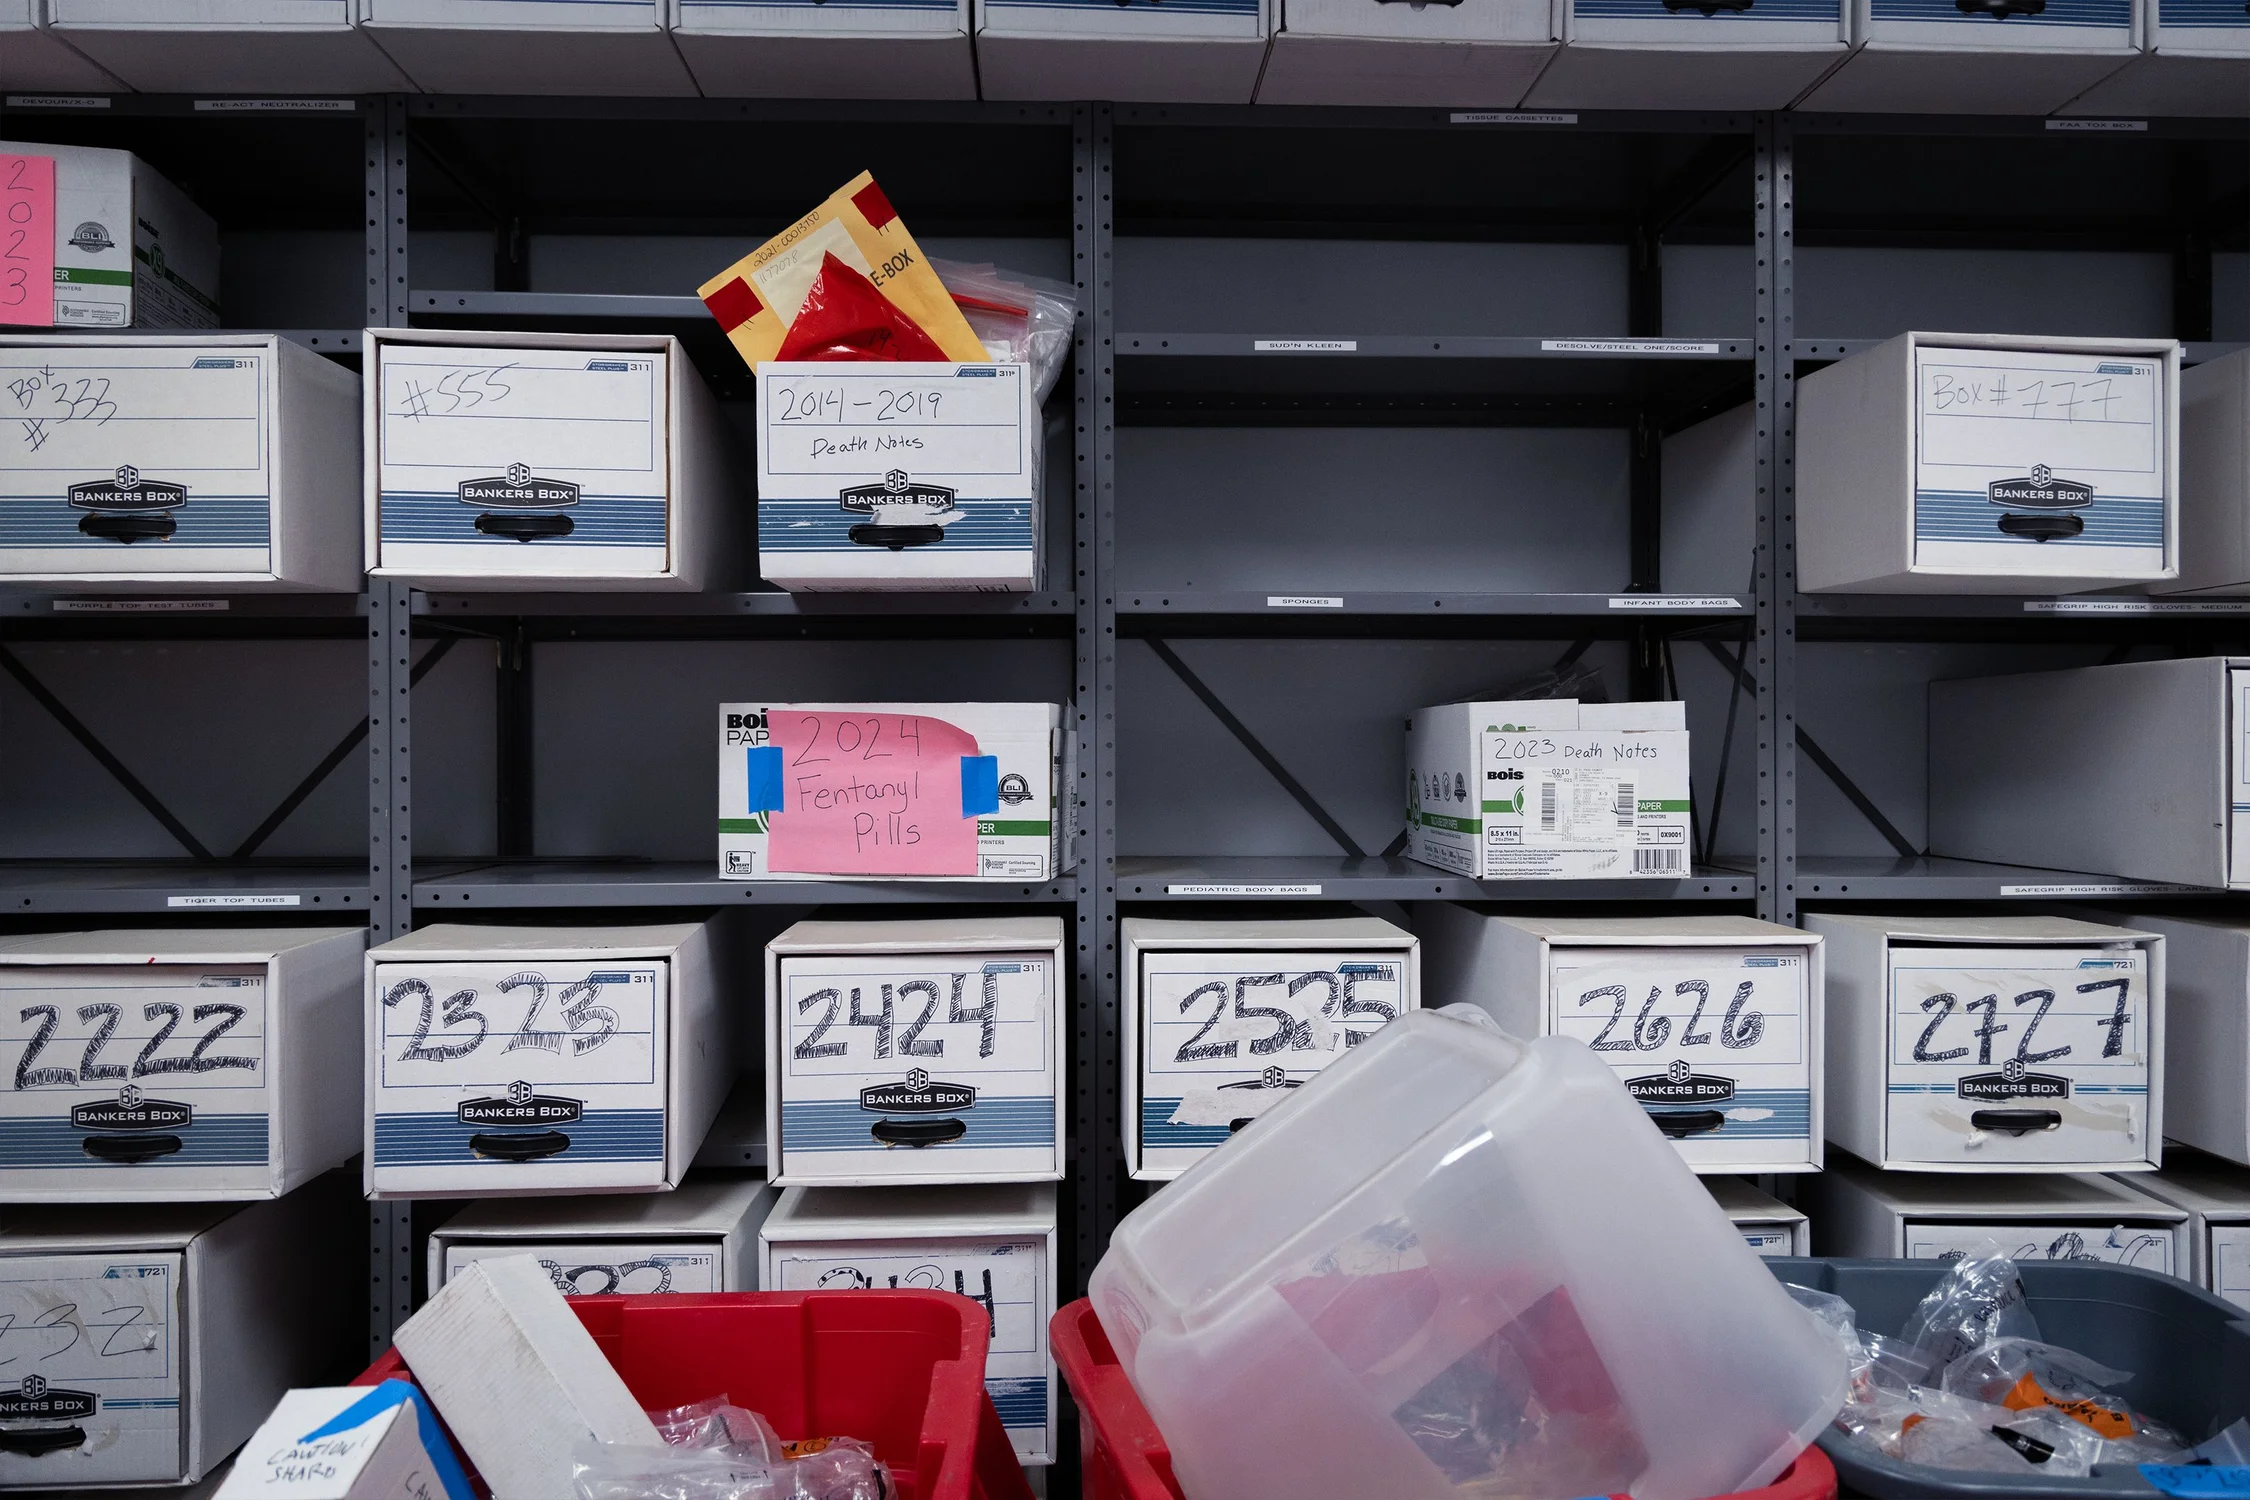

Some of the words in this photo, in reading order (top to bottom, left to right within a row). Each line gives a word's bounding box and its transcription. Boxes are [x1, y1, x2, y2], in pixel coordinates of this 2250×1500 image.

[235, 361, 254, 369] 311
[630, 363, 649, 371] 311
[2134, 367, 2151, 376] 311
[1933, 375, 1982, 409] Box
[52, 378, 117, 427] 333
[810, 435, 868, 459] Death
[875, 434, 924, 453] Notes
[74, 491, 142, 501] BANKERS
[465, 487, 534, 499] BANKERS
[1994, 487, 2054, 500] BANKERS
[847, 495, 913, 505] BANKERS
[918, 495, 946, 505] BOX
[791, 715, 920, 767] 2024
[1494, 737, 1556, 760] 2023
[1564, 742, 1603, 759] Death
[1613, 743, 1658, 762] Notes
[797, 770, 919, 814] Fentanyl
[1637, 801, 1662, 810] PAPER
[854, 812, 921, 854] Pills
[2113, 961, 2133, 970] 721
[241, 978, 261, 987] 311
[634, 975, 654, 983] 311
[381, 970, 620, 1063] 2323
[794, 972, 998, 1060] 2424
[1579, 979, 1766, 1052] 2626
[1912, 977, 2131, 1065] 2727
[13, 1001, 261, 1091] 2222
[1630, 1084, 1693, 1096] BANKERS
[1963, 1082, 2027, 1094] BANKERS
[2030, 1083, 2060, 1094] BOX
[866, 1093, 932, 1104] BANKERS
[77, 1110, 146, 1121] BANKERS
[464, 1106, 535, 1118] BANKERS
[144, 1267, 167, 1276] 721
[54, 1400, 85, 1411] BOX
